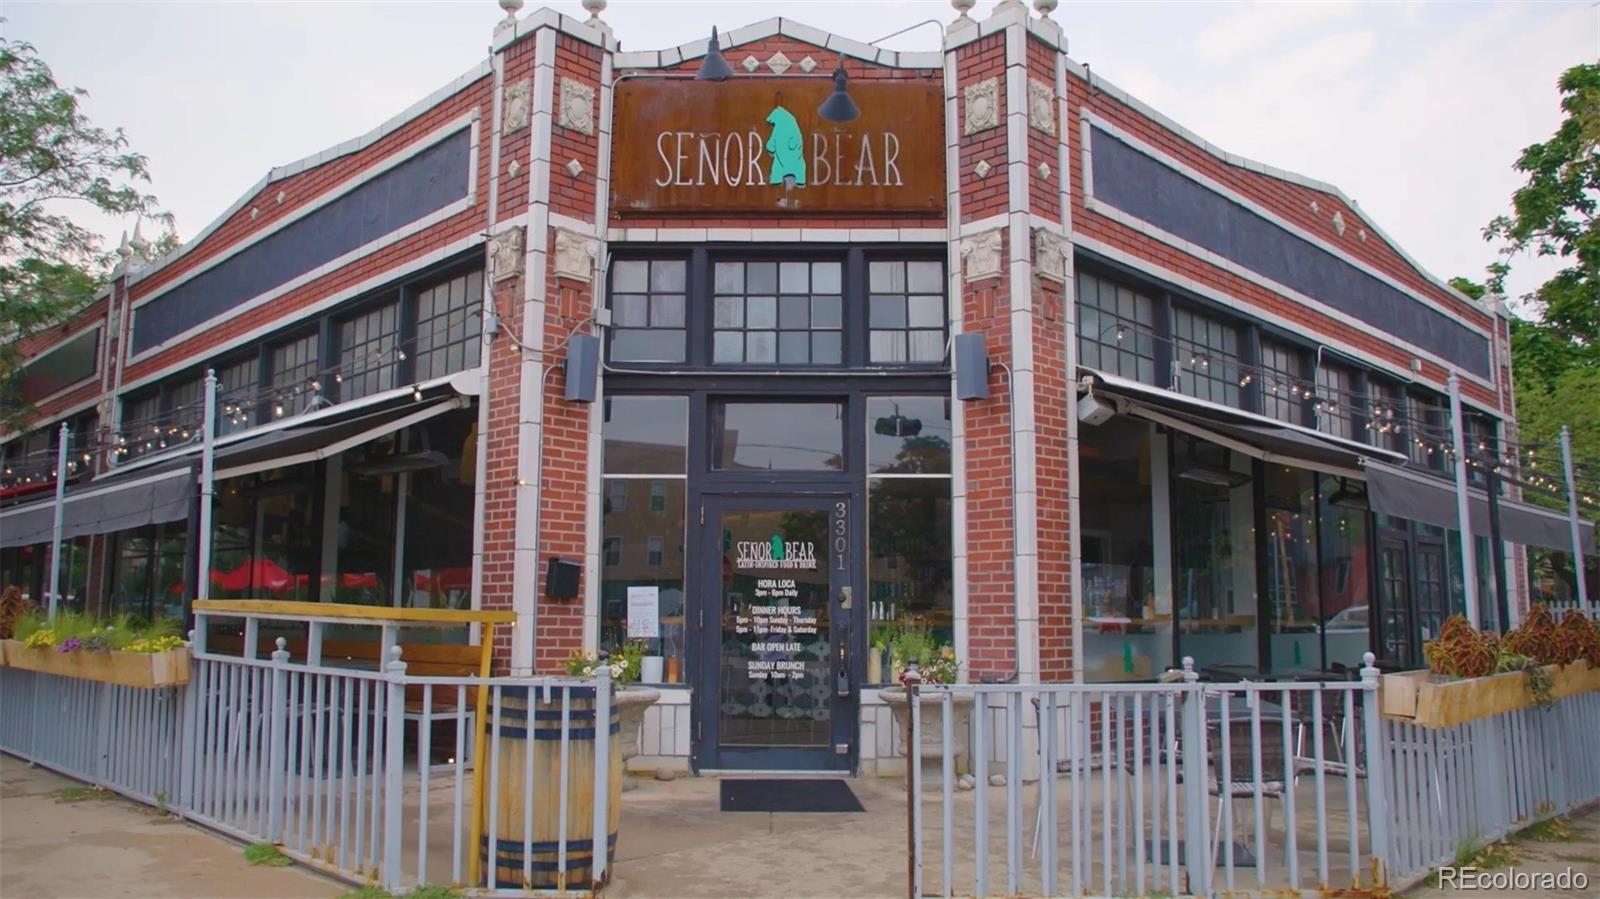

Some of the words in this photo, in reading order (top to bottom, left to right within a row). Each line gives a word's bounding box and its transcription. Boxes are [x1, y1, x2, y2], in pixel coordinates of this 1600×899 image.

[655, 129, 766, 187] SEÑOR
[810, 130, 904, 186] BEAR
[835, 502, 847, 570] 3301
[784, 541, 815, 561] BEAR
[757, 579, 777, 588] HORA
[778, 579, 796, 588] LOCA
[784, 588, 799, 597] Daily
[752, 606, 776, 615] DINNER
[777, 606, 802, 615] HOURS
[736, 616, 749, 625] 5pm
[769, 616, 789, 625] Sunday
[793, 616, 816, 625] Thursday
[735, 625, 748, 634] 5pm
[770, 625, 787, 634] Friday
[793, 625, 817, 634] Saturday
[751, 642, 766, 652] BAR
[766, 642, 785, 652] OPEN
[785, 642, 801, 652] LATE
[748, 661, 775, 670] SUNDAY
[776, 661, 805, 670] BRUNCH
[748, 671, 768, 680] Sunday
